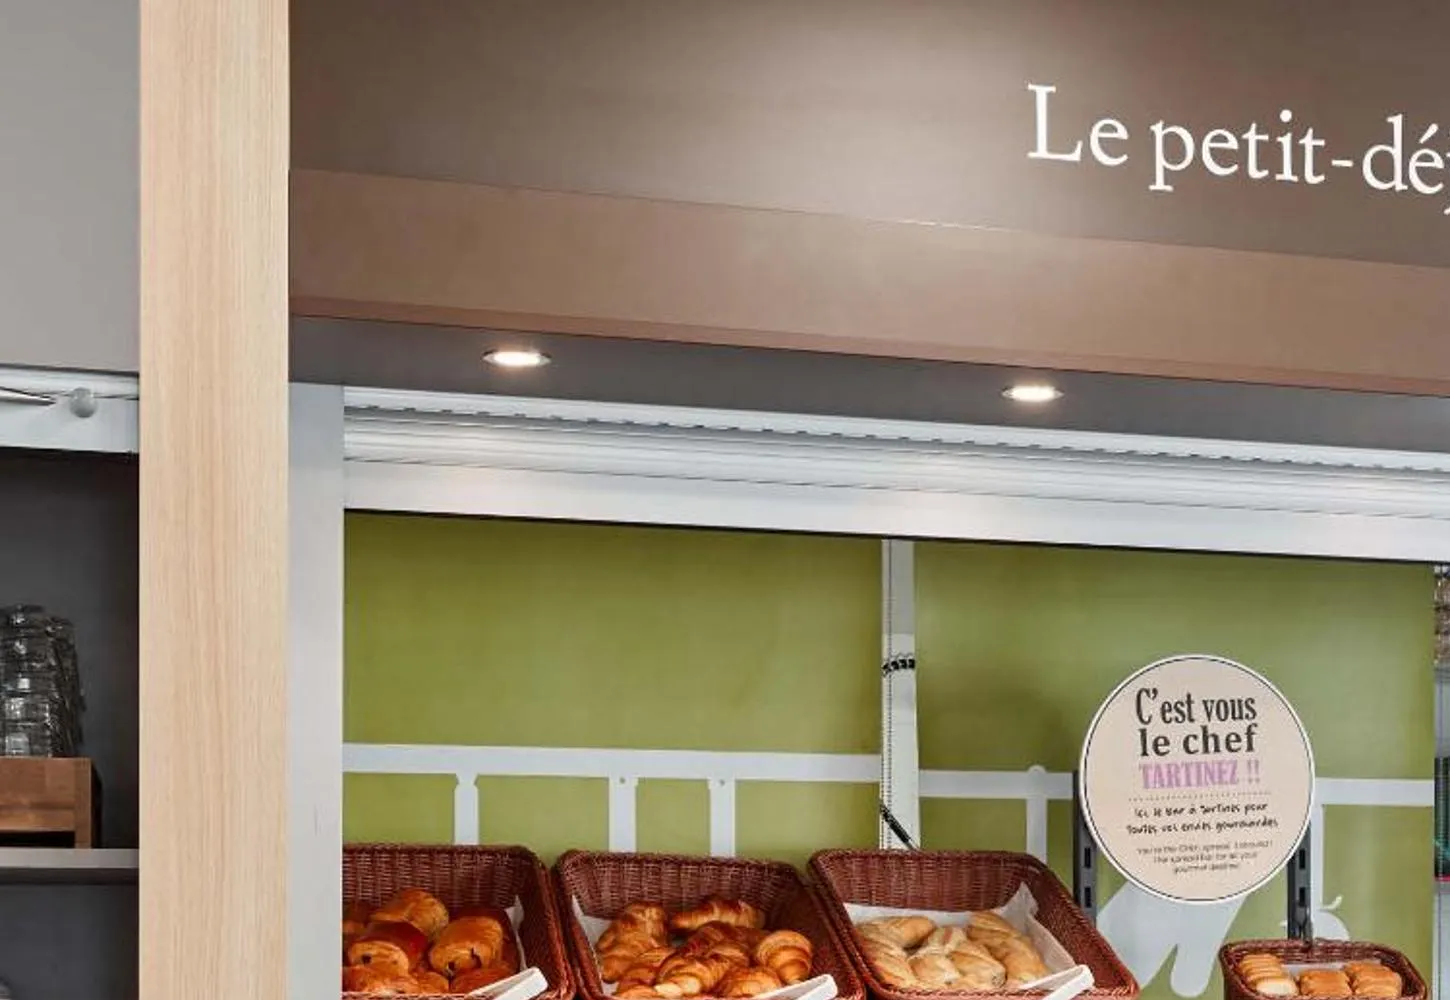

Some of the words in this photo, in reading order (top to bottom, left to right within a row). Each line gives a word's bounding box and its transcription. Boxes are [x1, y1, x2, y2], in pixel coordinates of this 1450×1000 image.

[1026, 82, 1129, 167] Le
[1136, 687, 1195, 725] C'est
[1202, 697, 1257, 722] vous
[1138, 728, 1170, 756] le
[1183, 723, 1258, 755] chef
[1138, 759, 1238, 789] TARTINEZ
